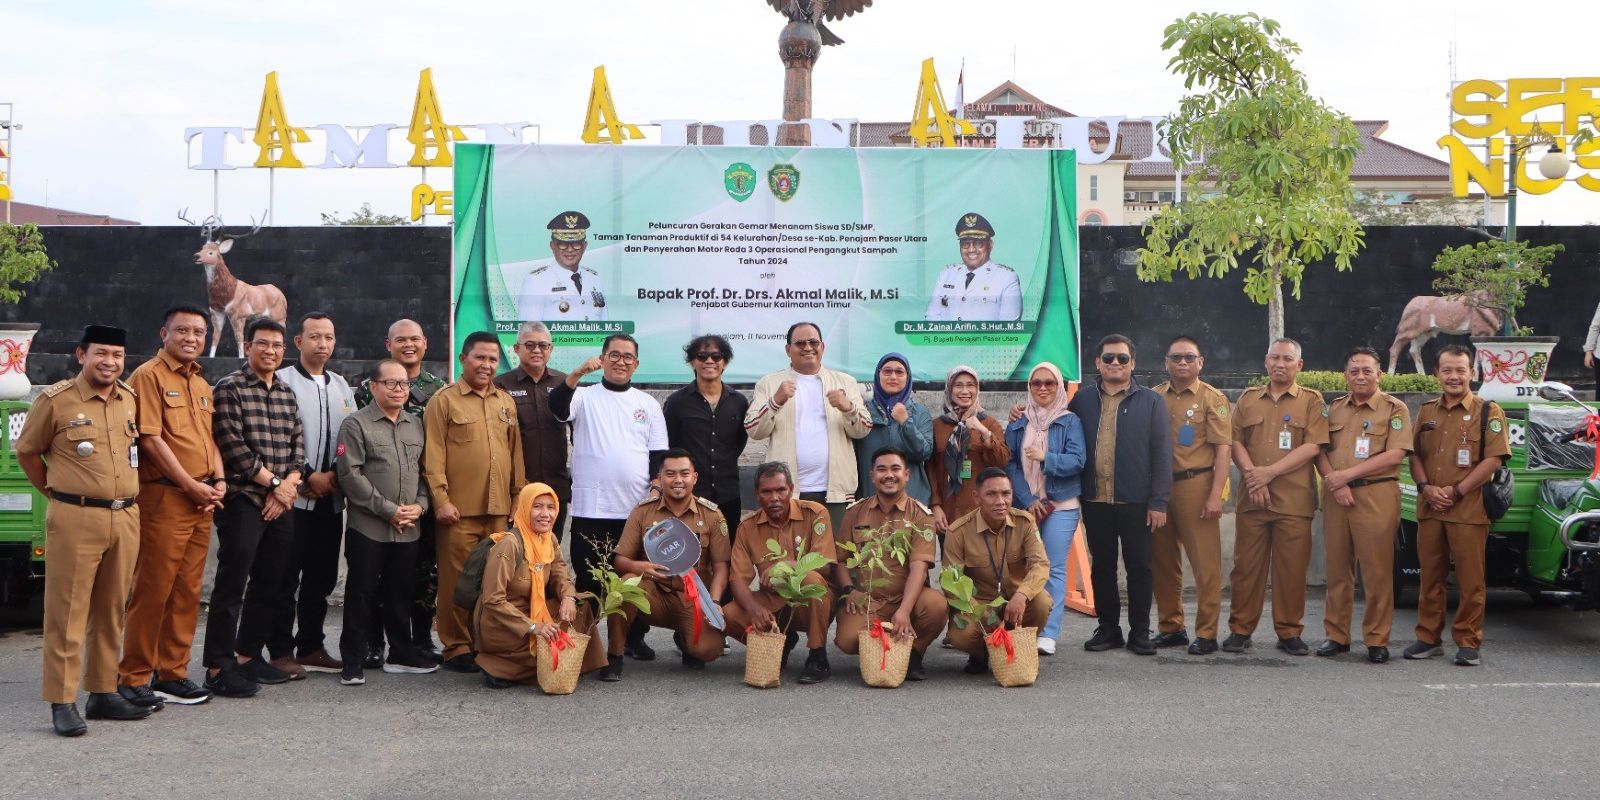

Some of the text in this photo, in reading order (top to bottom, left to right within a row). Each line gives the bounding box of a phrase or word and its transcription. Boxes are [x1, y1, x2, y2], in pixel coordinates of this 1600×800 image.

[1015, 103, 1047, 112] DATANG
[648, 222, 875, 232] Peluncuran Gerakan Gemar Menanam Siswa SD/SMP,
[593, 233, 624, 241] Taman
[733, 234, 802, 243] Kelurahan/Desa
[804, 234, 838, 242] se-Kab.
[839, 235, 877, 244] Penajam
[624, 245, 641, 253] dan
[643, 246, 696, 255] Penyerahan
[754, 246, 807, 255] Operasional
[808, 246, 860, 255] Pengangkut
[862, 247, 897, 256] Sampah
[738, 257, 788, 265] Tahun 2024
[637, 288, 899, 302] Bapak Prof. Dr. Drs. Akmal Malik, M.Si
[691, 301, 851, 310] Penjabat Gubernur Kalimantan Timur
[496, 323, 516, 331] Prof.
[551, 323, 577, 331] Akmal
[605, 323, 623, 331] M.Si
[903, 323, 916, 331] Dr.
[917, 323, 926, 331] M.
[928, 323, 953, 331] Zainal
[923, 336, 932, 344] Pj.
[933, 336, 953, 344] Bupati
[955, 336, 982, 344] Penajam
[1002, 335, 1019, 343] Utara
[661, 541, 680, 555] VIAR
